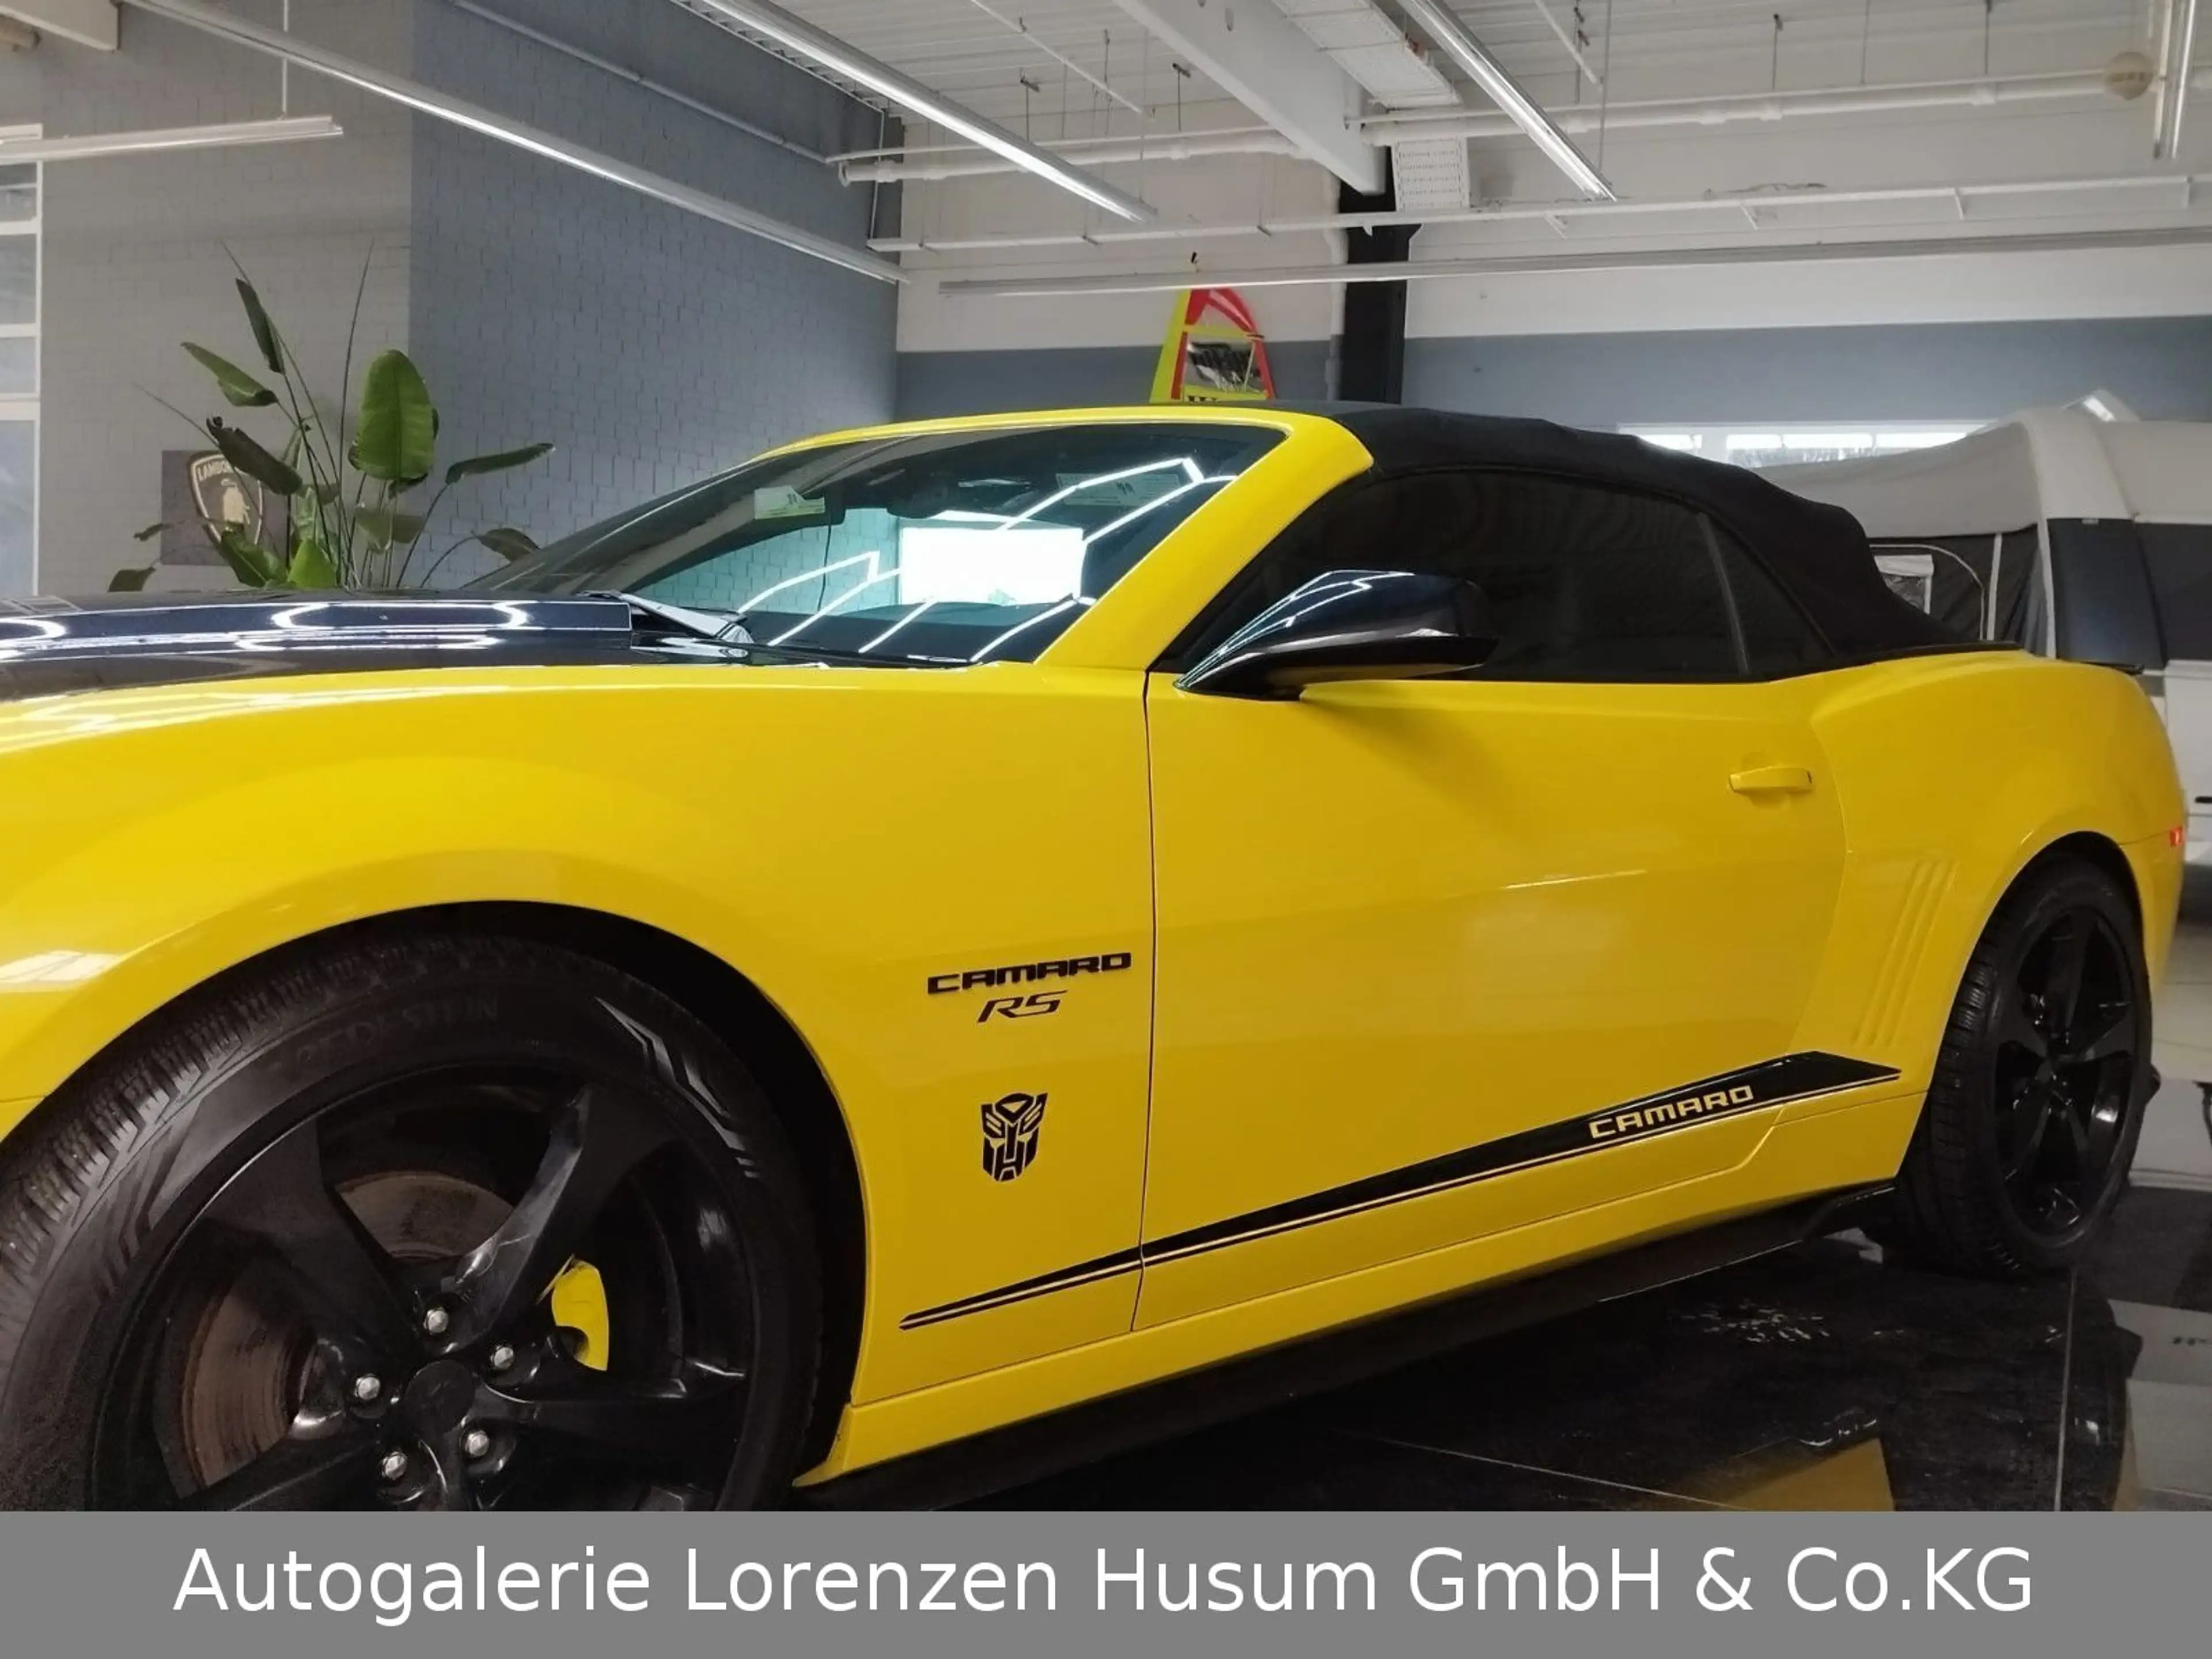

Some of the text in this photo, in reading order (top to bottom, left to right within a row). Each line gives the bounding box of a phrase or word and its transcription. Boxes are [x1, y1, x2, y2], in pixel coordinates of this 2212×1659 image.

[927, 952, 1131, 995] CAMARO
[977, 989, 1068, 1024] RS
[1589, 1085, 1754, 1139] CAMARO
